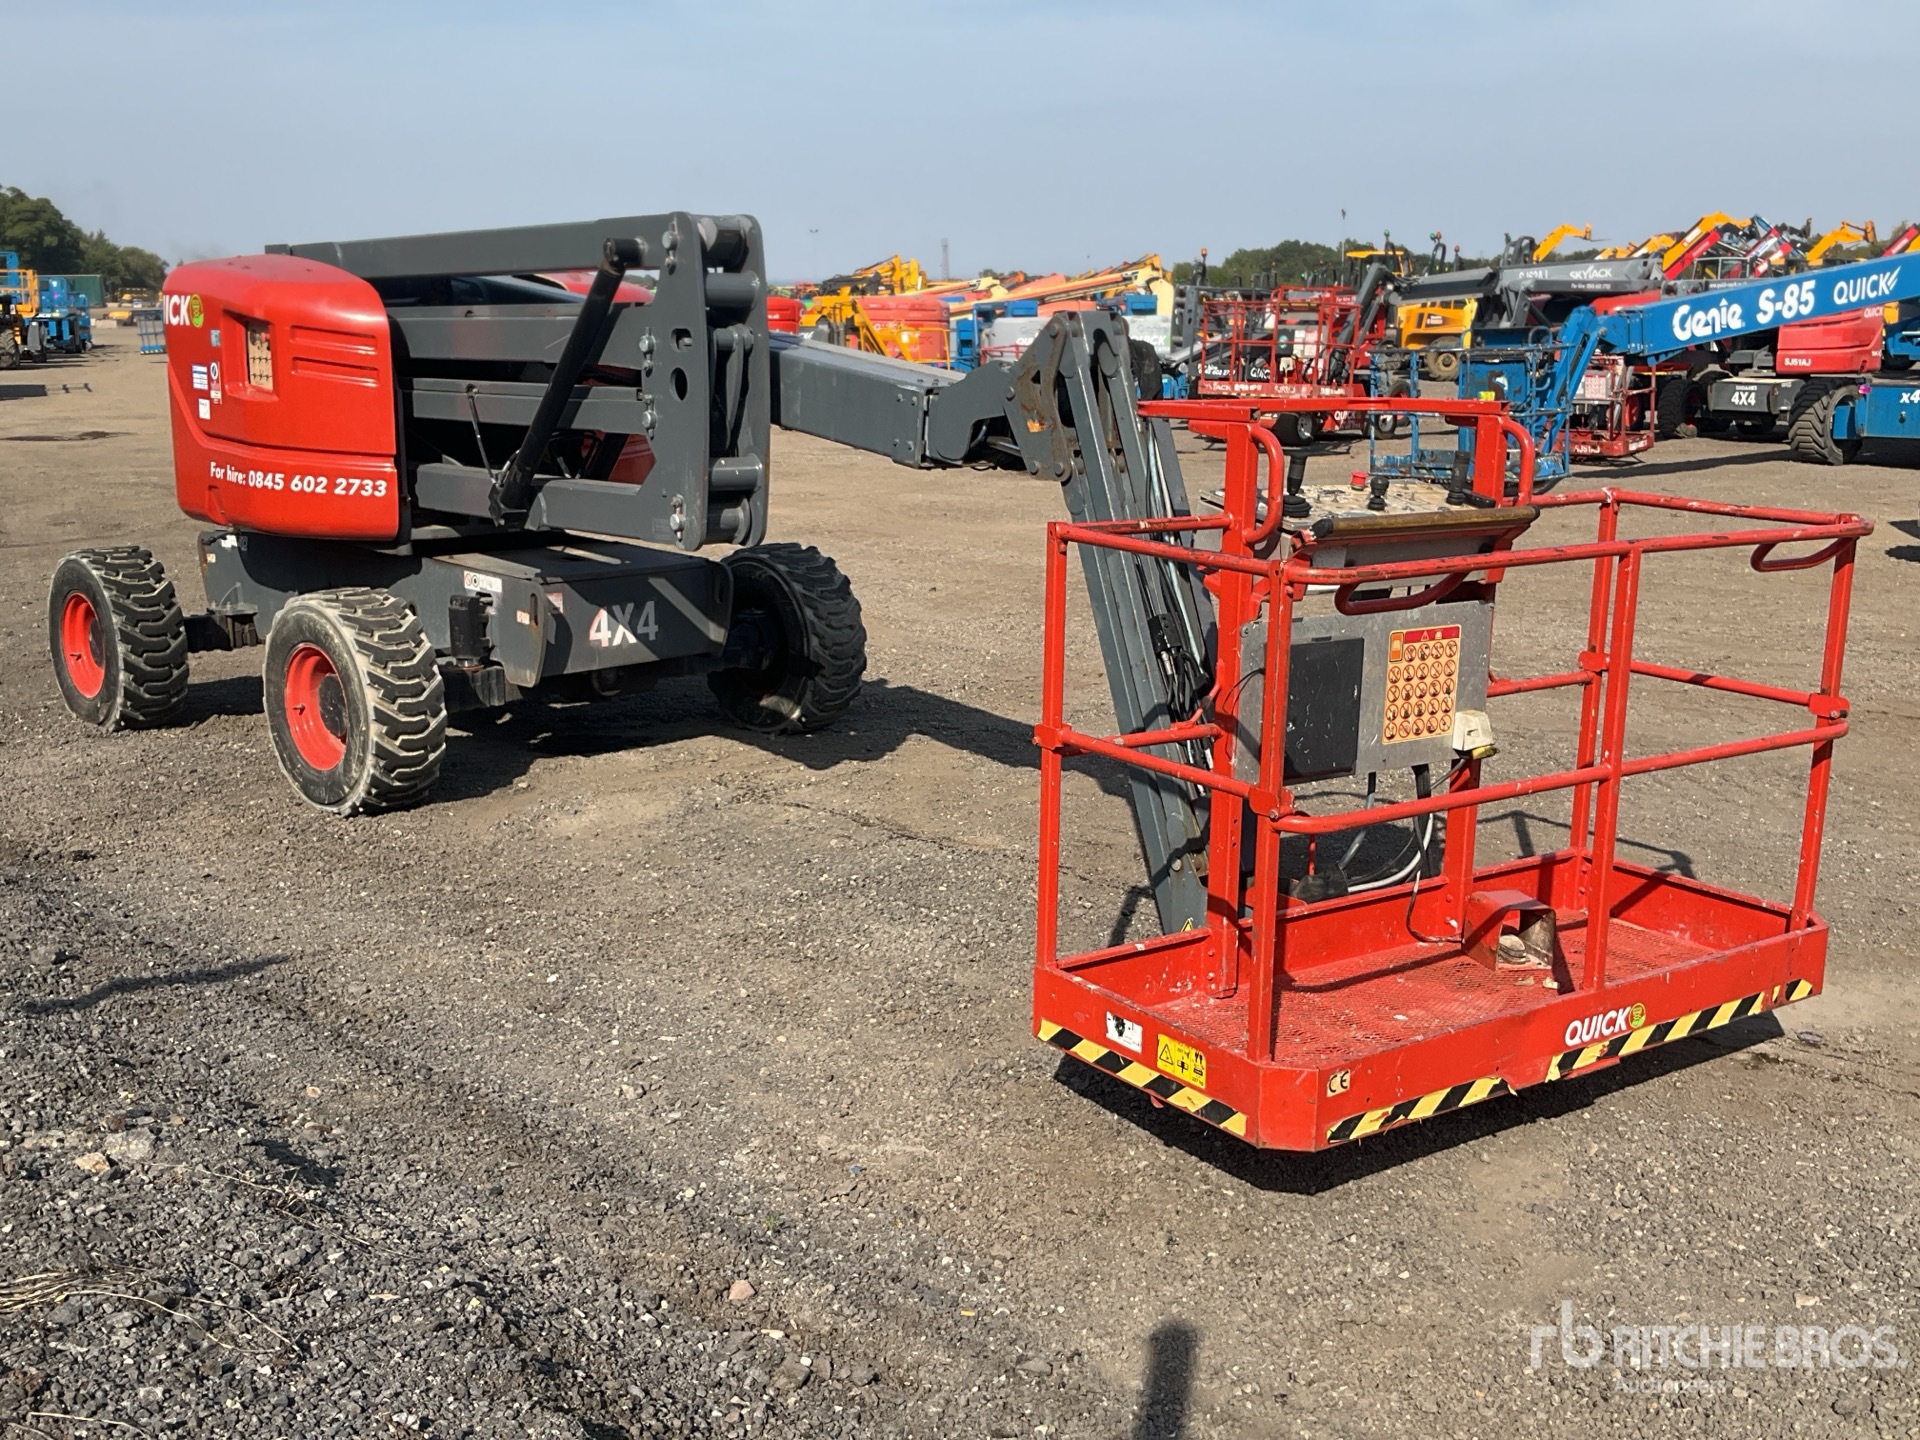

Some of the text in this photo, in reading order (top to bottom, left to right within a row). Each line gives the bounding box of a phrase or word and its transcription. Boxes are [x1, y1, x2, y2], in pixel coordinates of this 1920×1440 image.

[1569, 264, 1613, 280] SKYJACK
[1832, 268, 1898, 307] QUICK
[162, 295, 191, 326] ICK
[1672, 279, 1816, 342] Genie S-85
[1784, 357, 1812, 367] SJ51AJ
[1730, 391, 1757, 406] 4X4
[210, 461, 388, 497] For hire: 0845 602 2733
[588, 600, 659, 648] 4X4
[1564, 1006, 1632, 1048] QUICK
